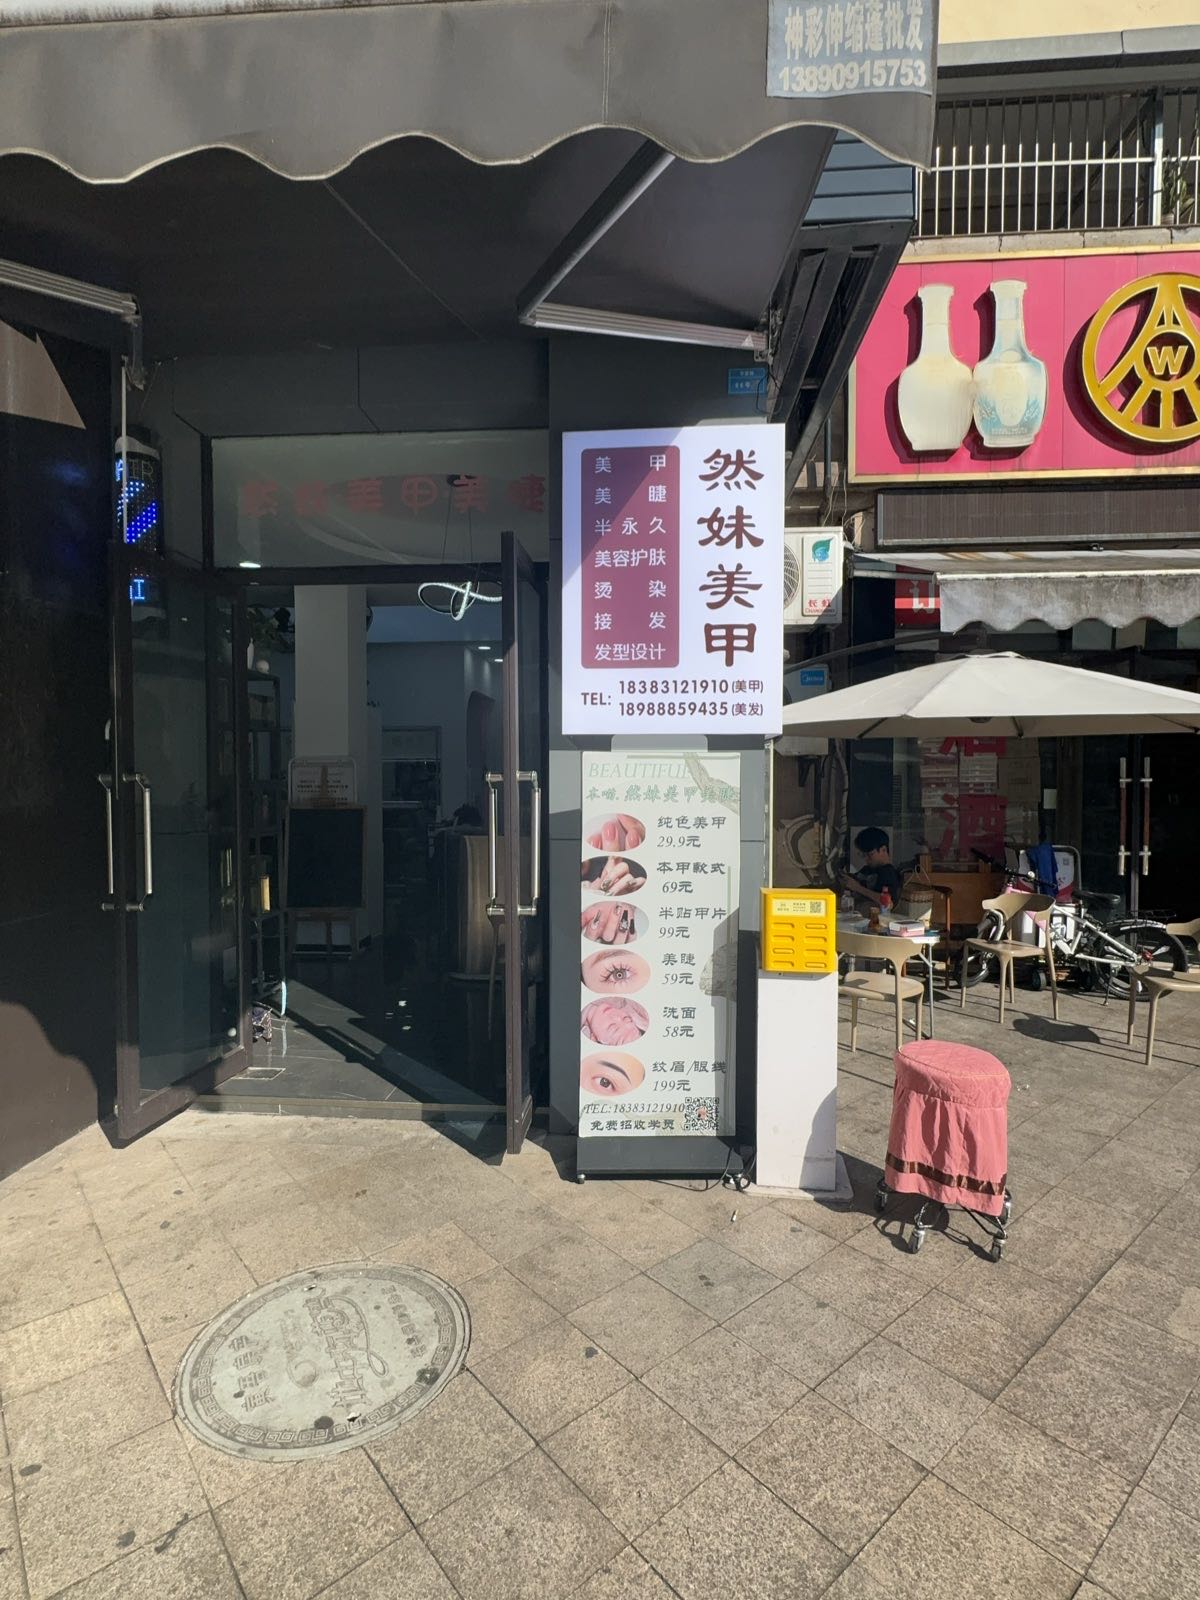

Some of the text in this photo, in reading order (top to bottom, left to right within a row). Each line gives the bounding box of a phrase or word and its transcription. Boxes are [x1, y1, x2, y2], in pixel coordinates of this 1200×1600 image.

[779, 58, 927, 92] 13890915753
[1147, 345, 1189, 375] W
[594, 454, 666, 473] 美 甲
[594, 485, 667, 504] 美 睫
[594, 516, 667, 536] 半永久
[594, 548, 667, 568] 美容护肤
[697, 448, 765, 668] 然妹美甲
[594, 580, 667, 599] 烫 染
[594, 612, 667, 630] 接 发
[594, 643, 666, 661] 发型设计
[619, 679, 729, 694] 18383121910
[581, 693, 611, 706] TEL:
[619, 702, 729, 716] 18988859435
[657, 815, 727, 830] 纯色美甲
[657, 835, 701, 848] 29.9元
[662, 881, 693, 894] 69元
[659, 906, 727, 920] 半贴甲片
[659, 926, 690, 939] 99元
[662, 953, 696, 967] 美睫
[662, 972, 694, 985] 59元
[662, 1006, 697, 1020] 洗面
[662, 1025, 694, 1038] 58元
[652, 1060, 727, 1076] 纹眉/眼线
[653, 1079, 691, 1092] 199元
[584, 1103, 684, 1113] TEL:18383121910
[590, 1119, 675, 1131] 免费招收学员
